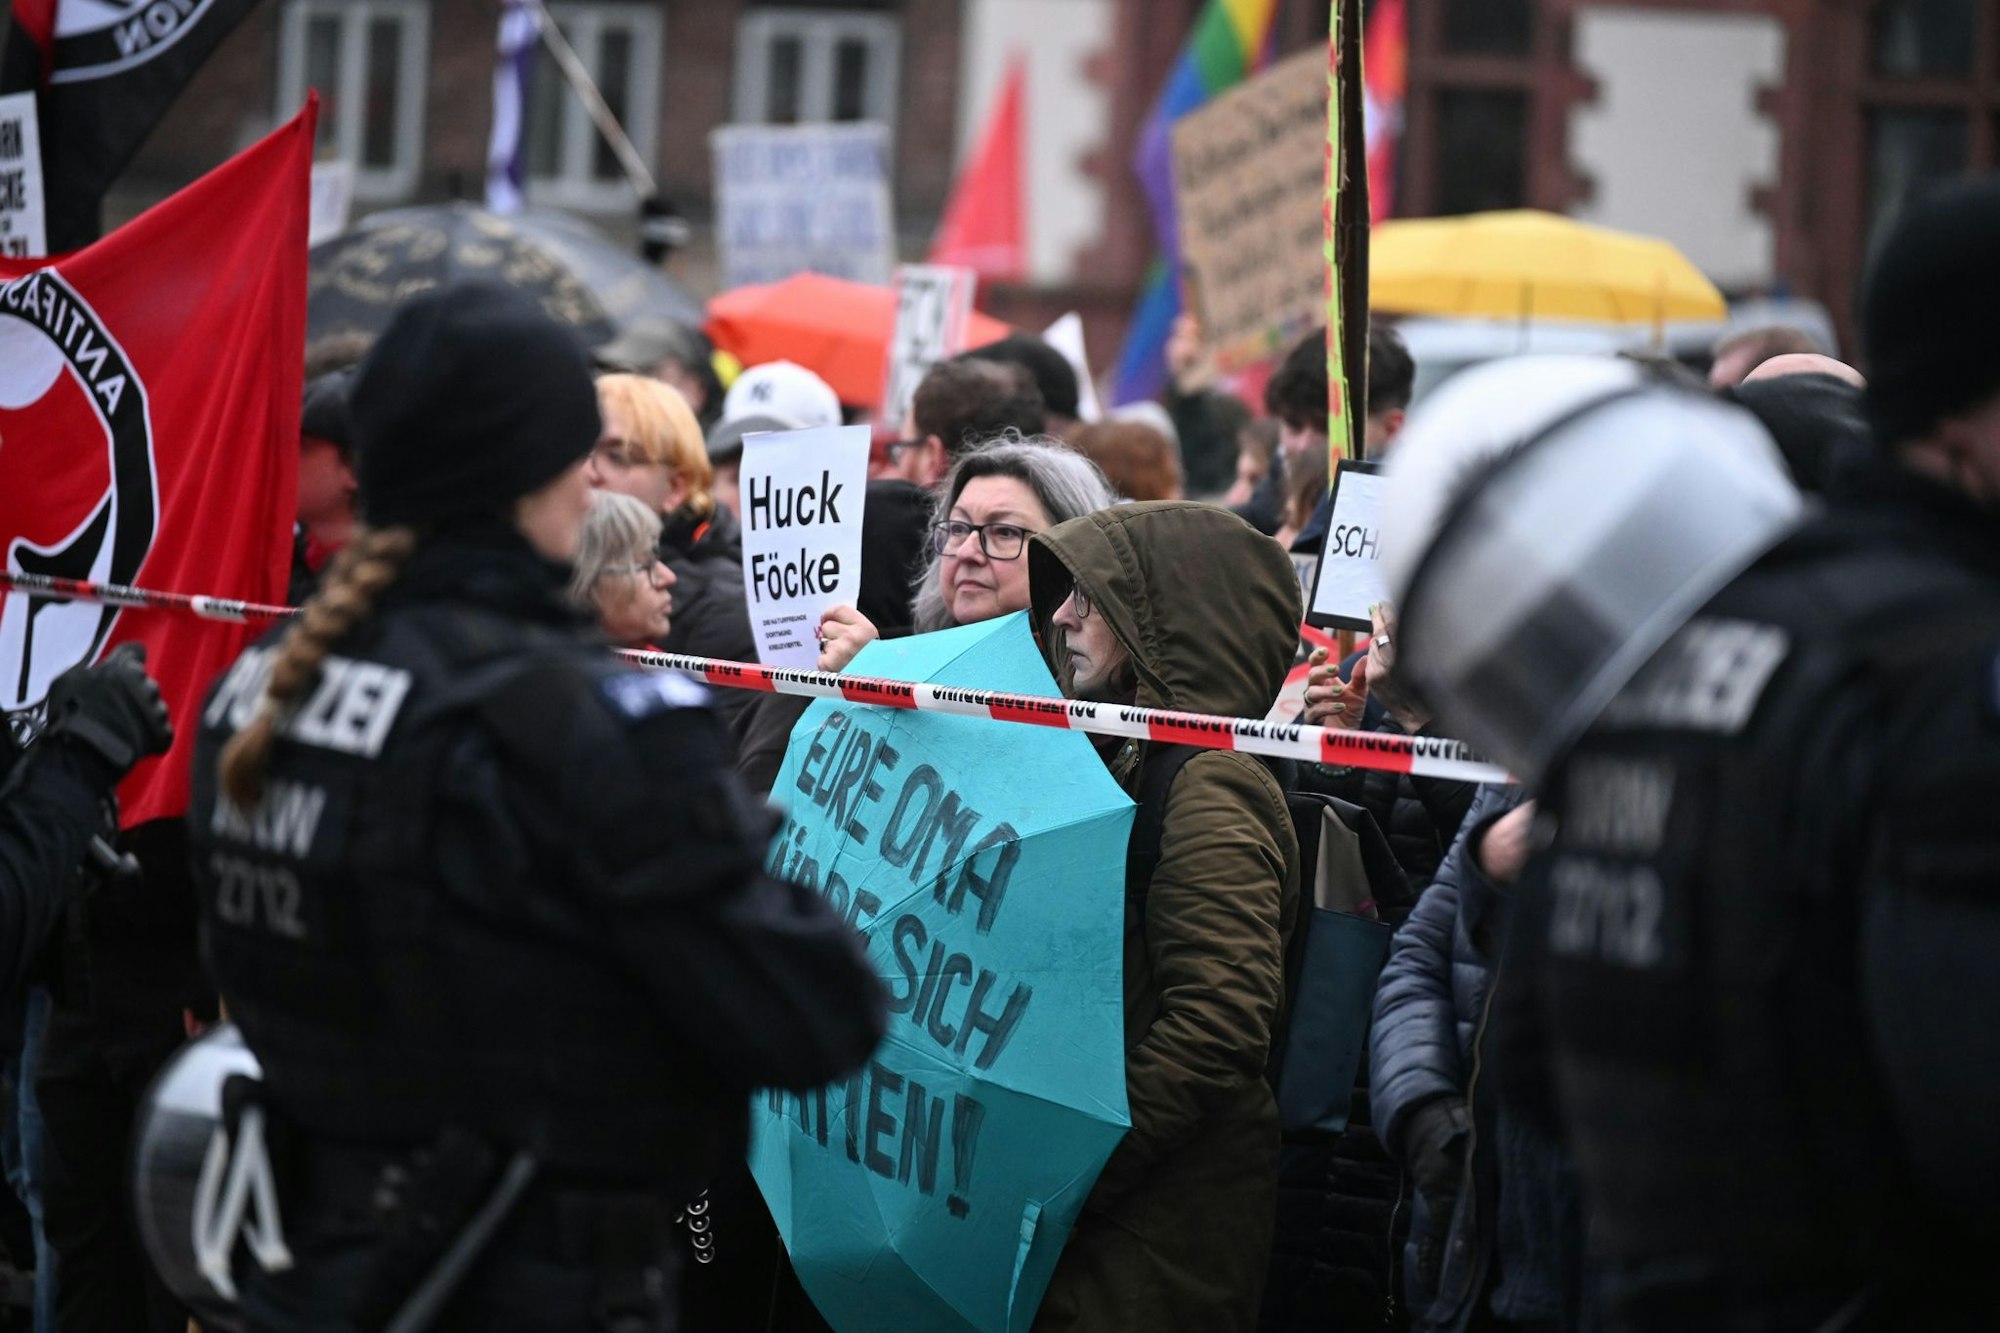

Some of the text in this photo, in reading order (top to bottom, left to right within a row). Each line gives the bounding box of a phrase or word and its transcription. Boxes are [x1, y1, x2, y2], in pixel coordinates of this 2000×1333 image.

[750, 470, 843, 531] Huck
[752, 548, 840, 603] Föcke
[203, 645, 412, 758] POZEI
[796, 710, 1022, 936] EURE OMA
[887, 913, 1033, 1072] SICH
